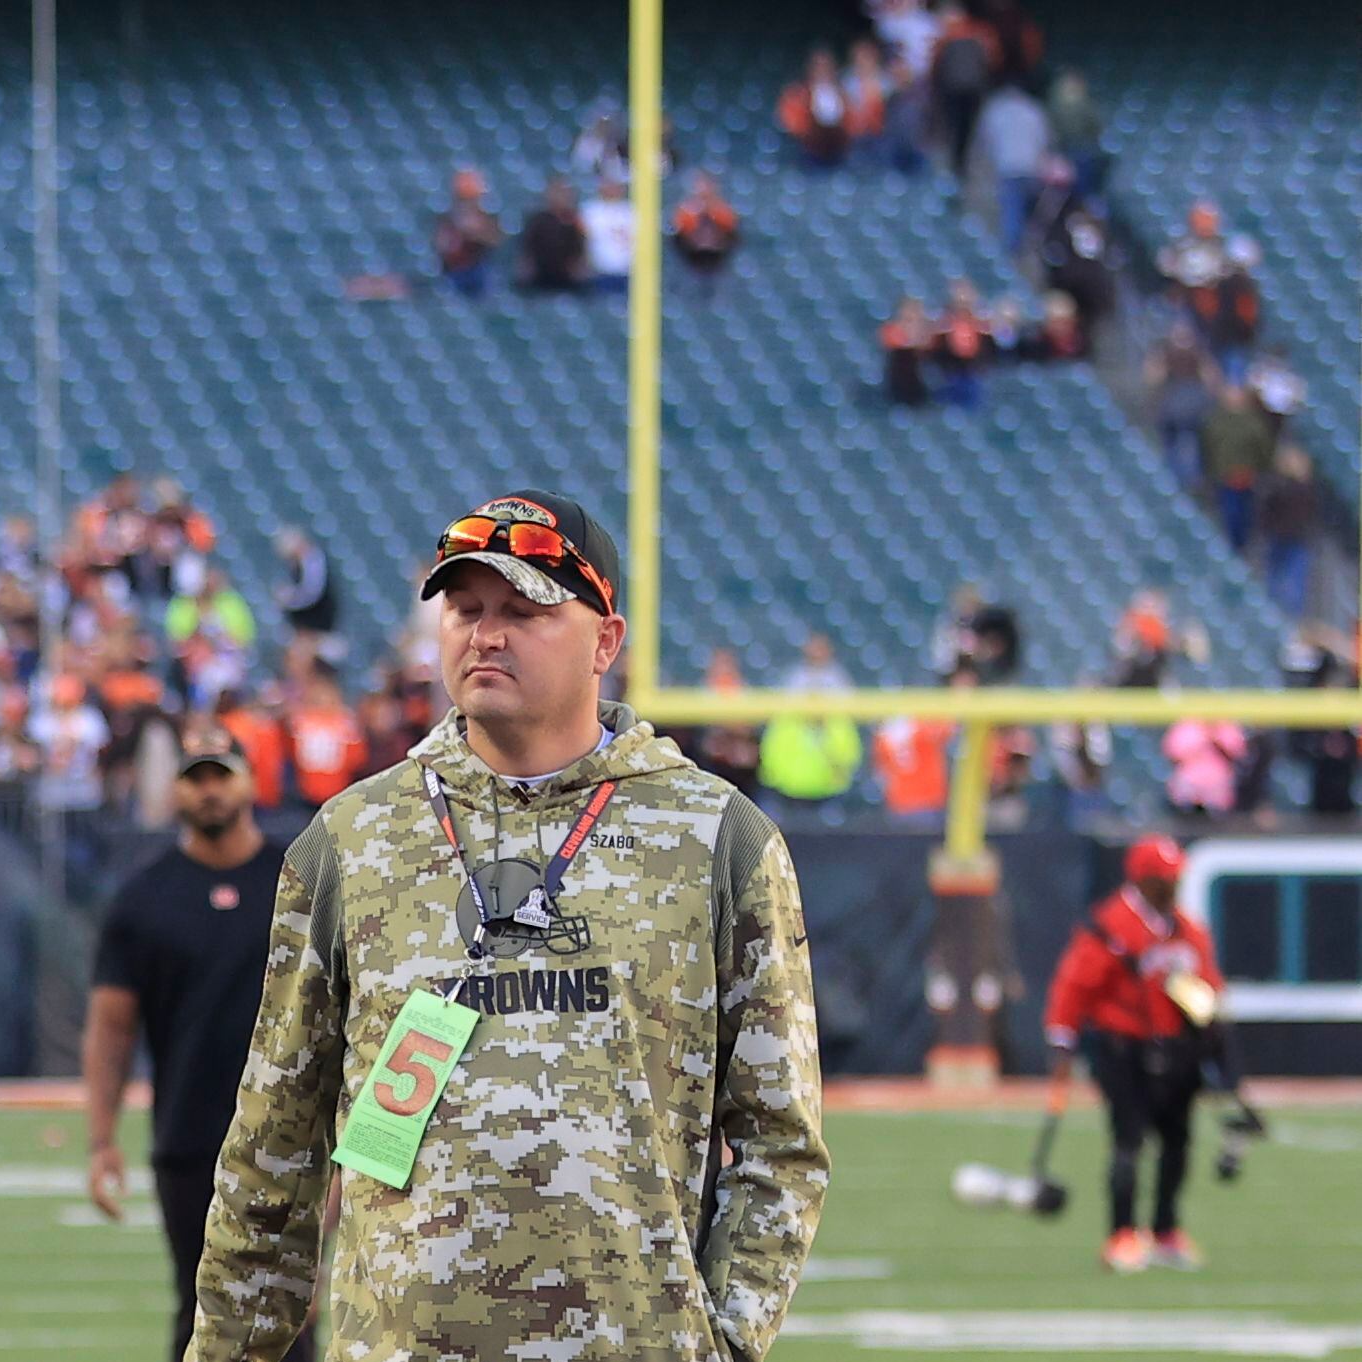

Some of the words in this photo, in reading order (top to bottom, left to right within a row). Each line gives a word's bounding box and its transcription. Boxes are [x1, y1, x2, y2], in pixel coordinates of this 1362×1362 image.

[590, 834, 634, 849] SZABO
[516, 910, 548, 925] SERVICE
[373, 1028, 454, 1117] 5
